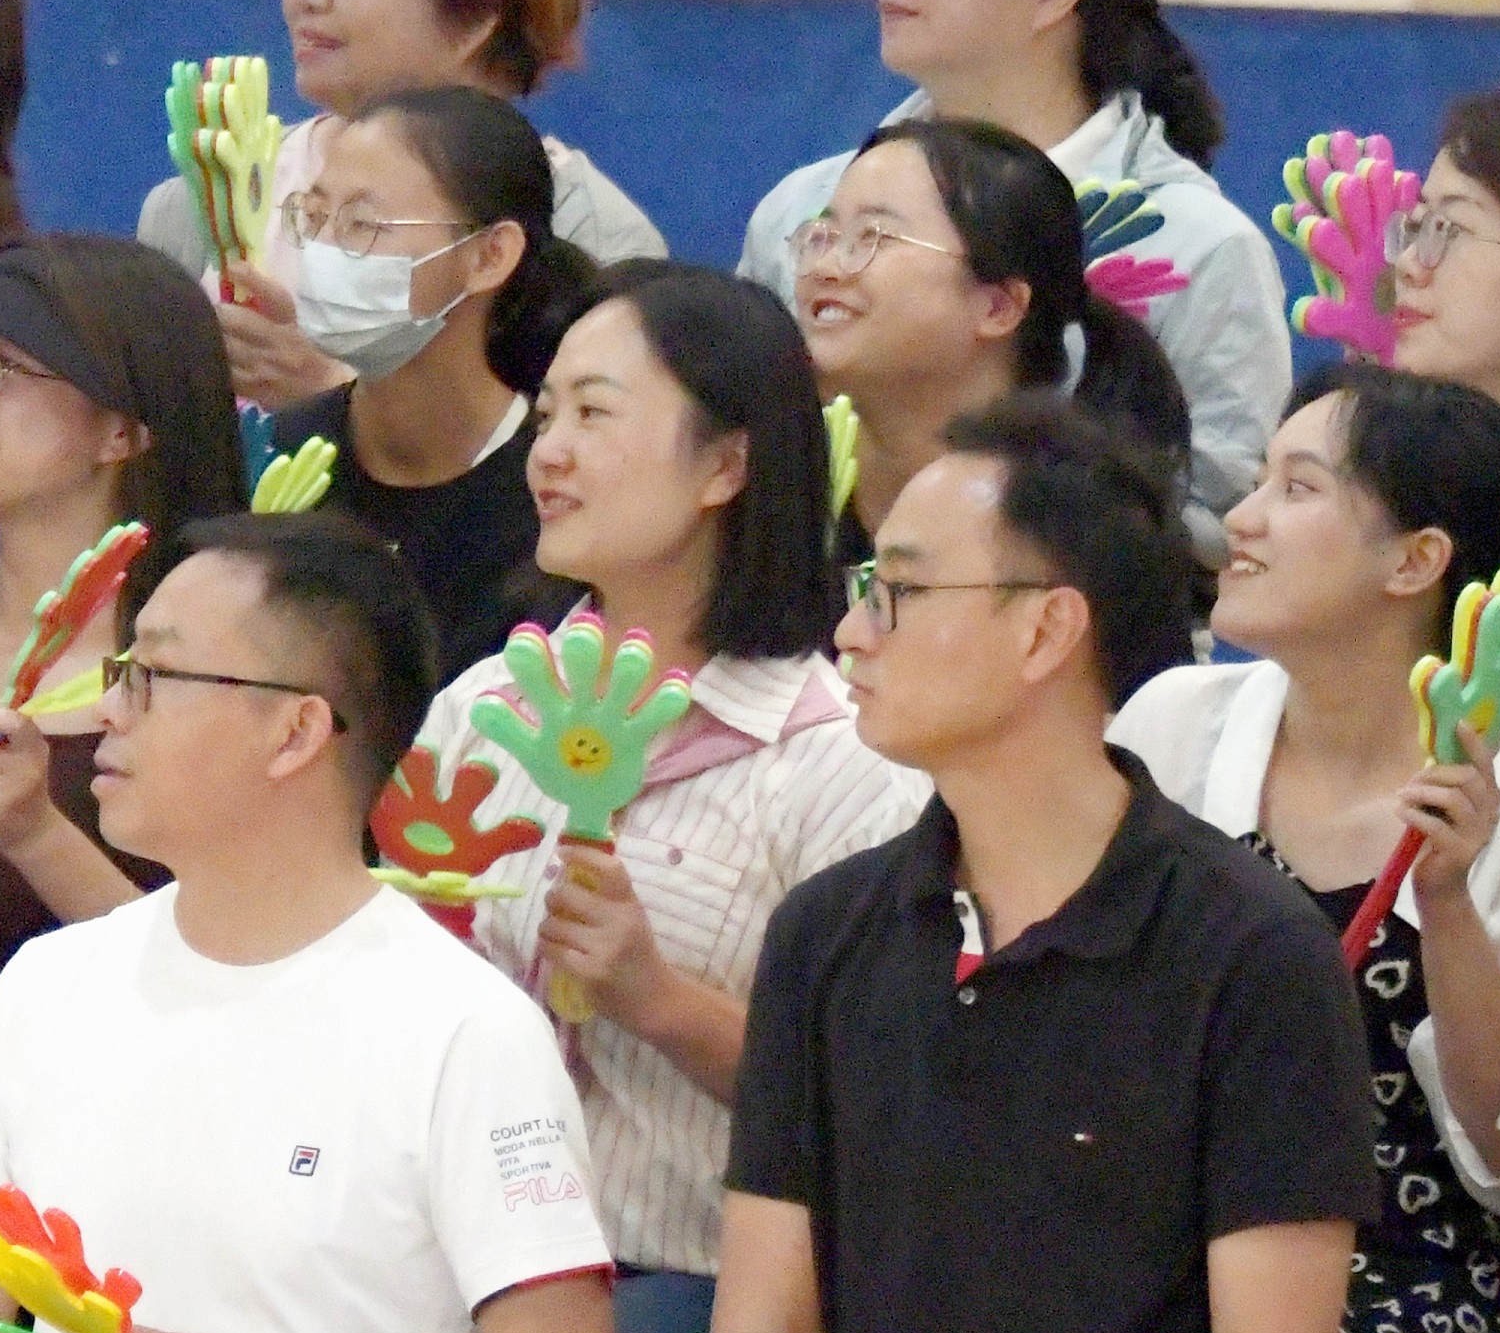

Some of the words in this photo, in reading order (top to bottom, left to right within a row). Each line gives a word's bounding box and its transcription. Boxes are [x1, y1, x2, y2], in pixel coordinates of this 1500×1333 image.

[489, 1118, 541, 1142] COURT
[493, 1141, 526, 1156] MODA
[528, 1134, 561, 1147] NELLA
[497, 1156, 521, 1168] VITA
[503, 1171, 583, 1213] FILA
